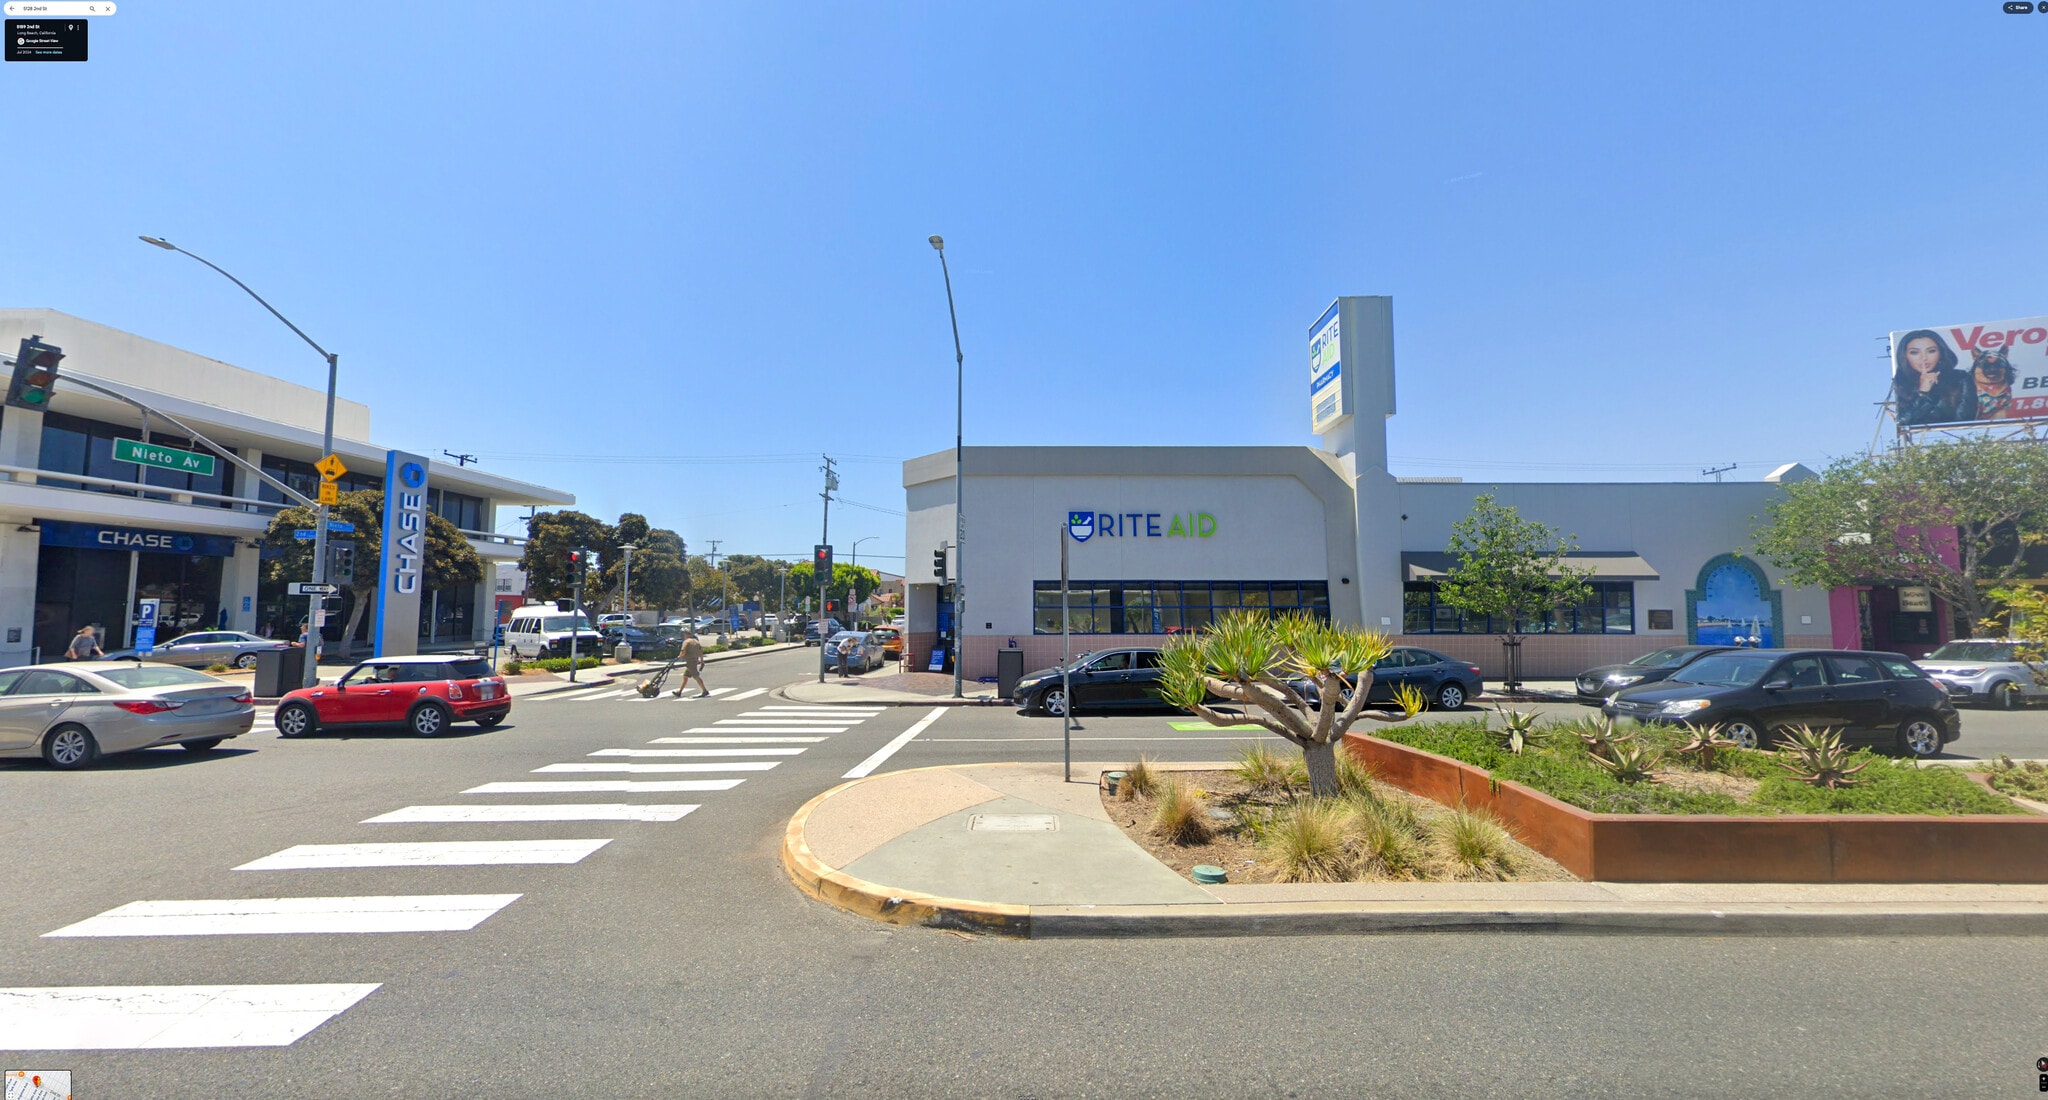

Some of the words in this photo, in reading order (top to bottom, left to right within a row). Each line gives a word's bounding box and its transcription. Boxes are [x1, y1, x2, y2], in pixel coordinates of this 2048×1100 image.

[1321, 321, 1339, 349] RITE
[1951, 326, 2048, 351] Vero
[1322, 342, 1336, 364] AID
[2014, 398, 2048, 410] 1.8
[132, 446, 172, 464] Nieto
[183, 456, 200, 468] Av
[1098, 513, 1162, 537] RITE
[1167, 513, 1218, 538] AID
[97, 530, 173, 548] CHASE
[397, 492, 421, 594] CHASE
[142, 605, 152, 619] P
